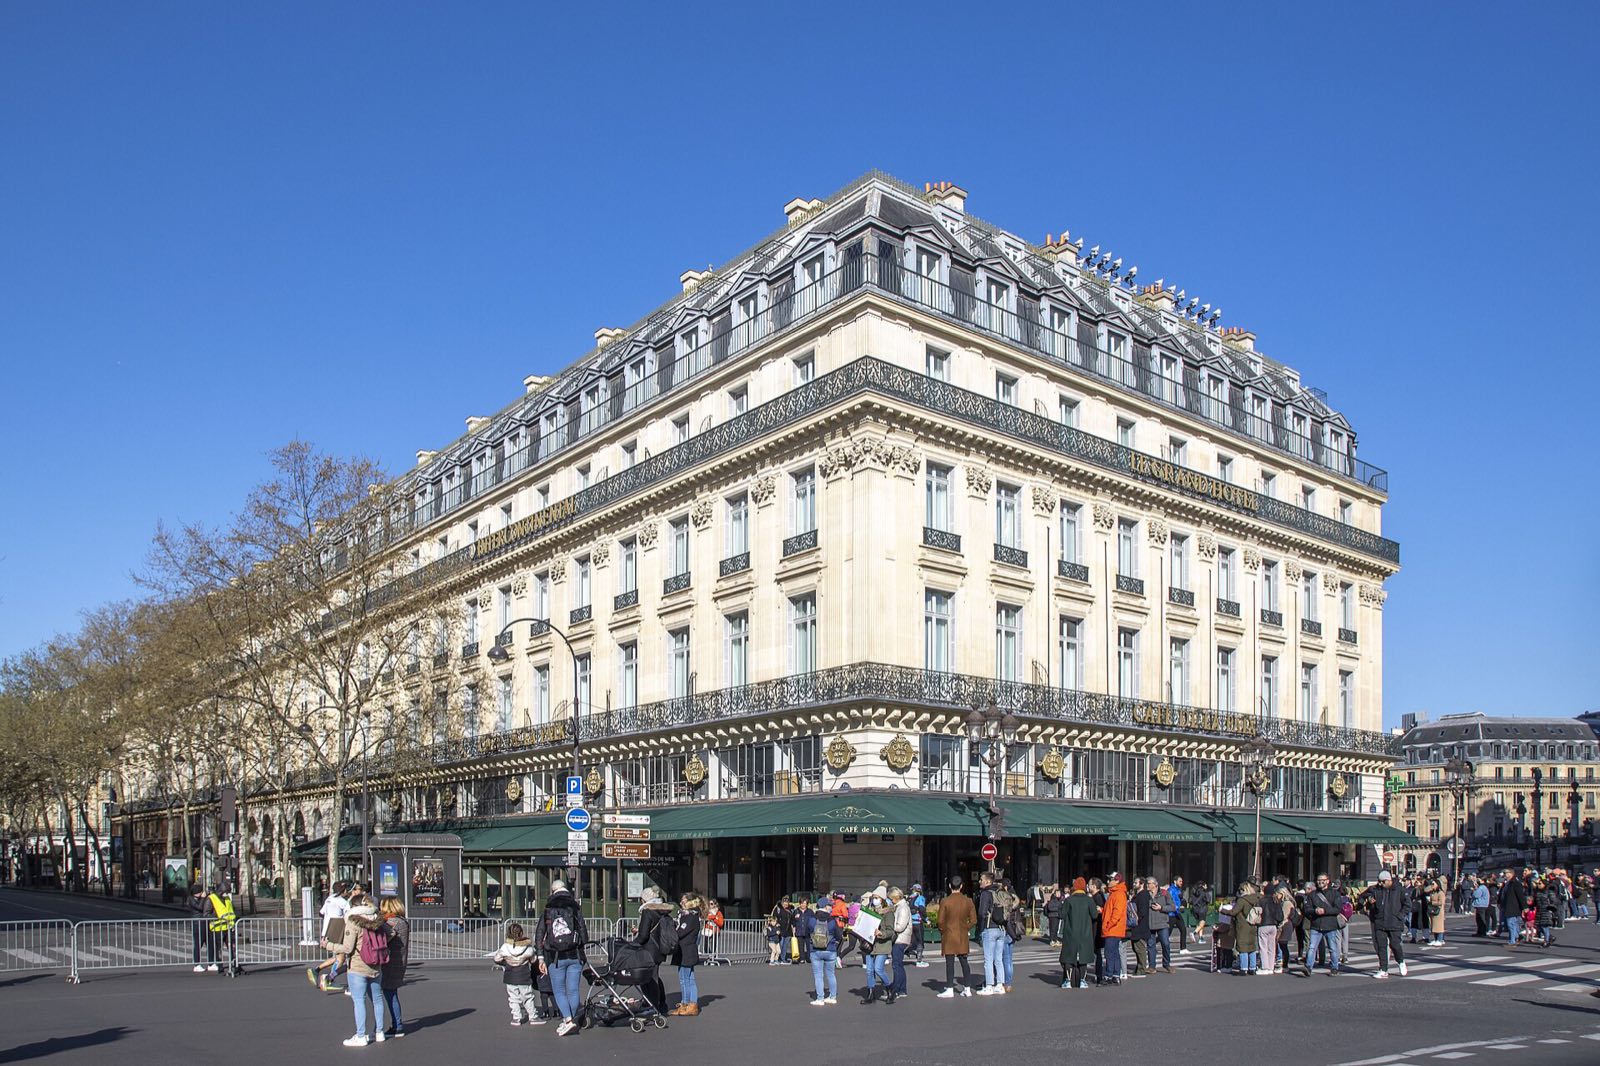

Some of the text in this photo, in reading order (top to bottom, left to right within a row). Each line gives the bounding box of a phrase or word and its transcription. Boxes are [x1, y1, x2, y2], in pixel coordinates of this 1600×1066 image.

[1129, 451, 1147, 474] LE
[1150, 460, 1208, 493] GRAND
[570, 780, 577, 791] P
[839, 825, 859, 833] CAFÉ
